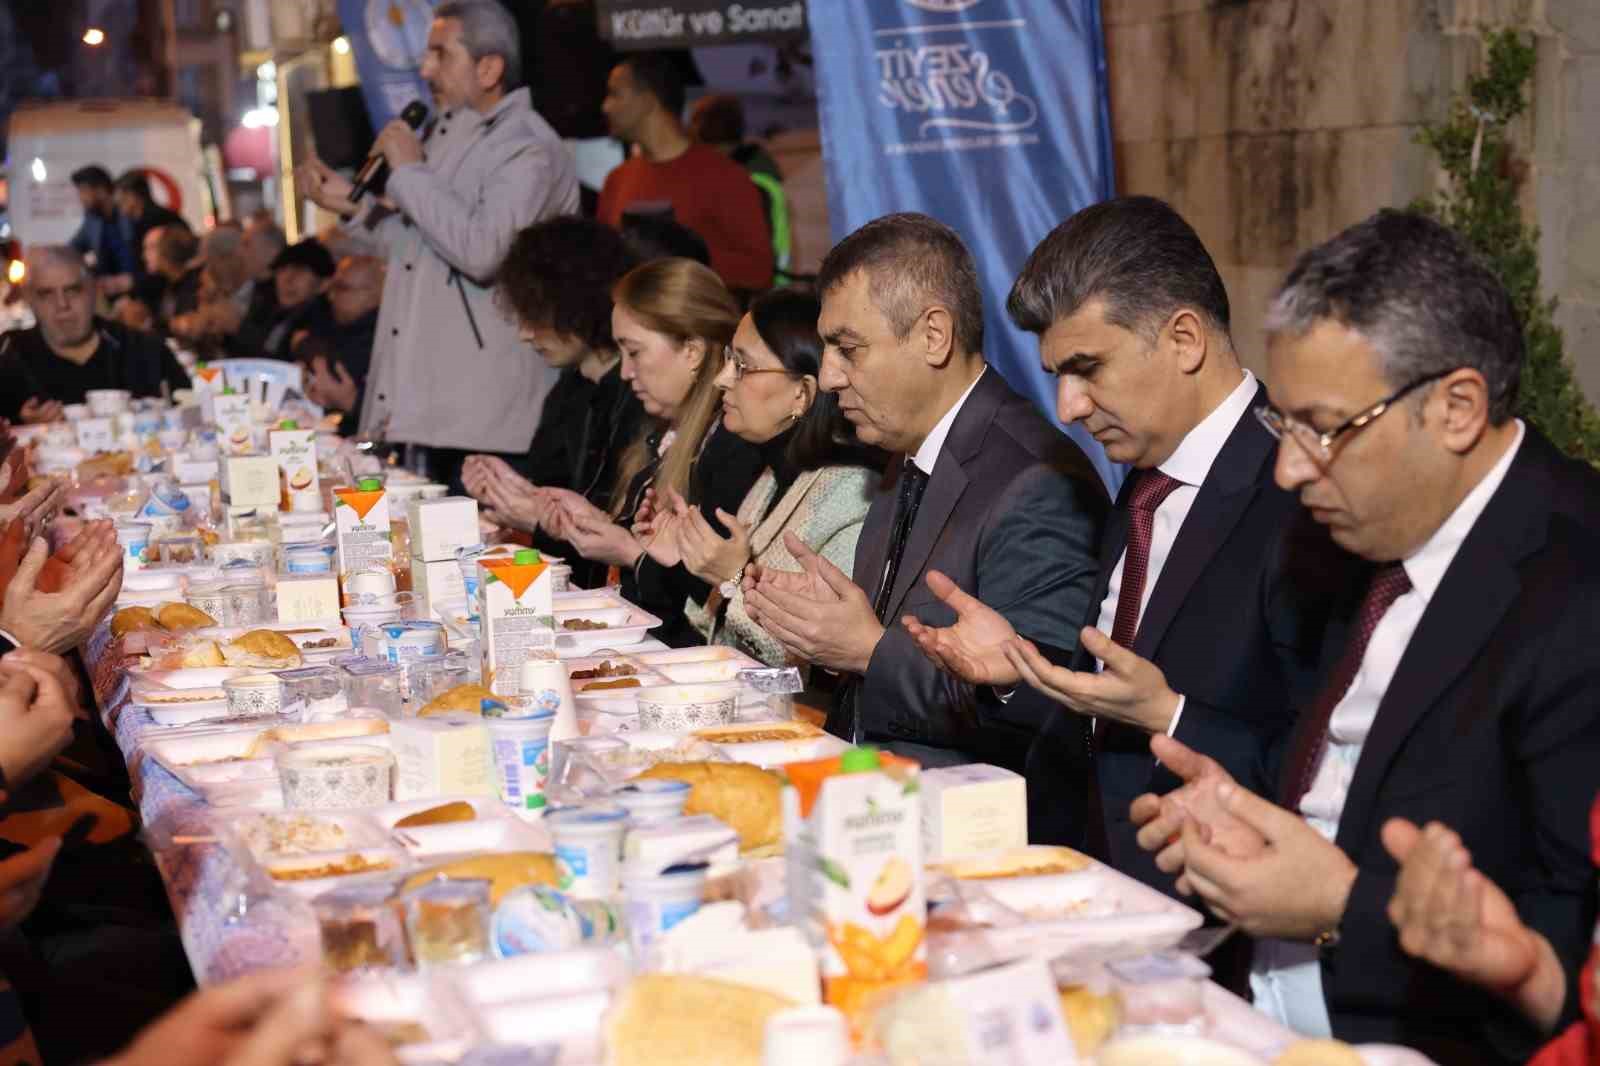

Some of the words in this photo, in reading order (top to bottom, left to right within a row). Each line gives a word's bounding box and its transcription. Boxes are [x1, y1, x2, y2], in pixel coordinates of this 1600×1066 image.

[611, 8, 685, 38] Kültür
[688, 11, 723, 35] ve
[727, 3, 803, 33] Sanat
[503, 606, 537, 617] yummy
